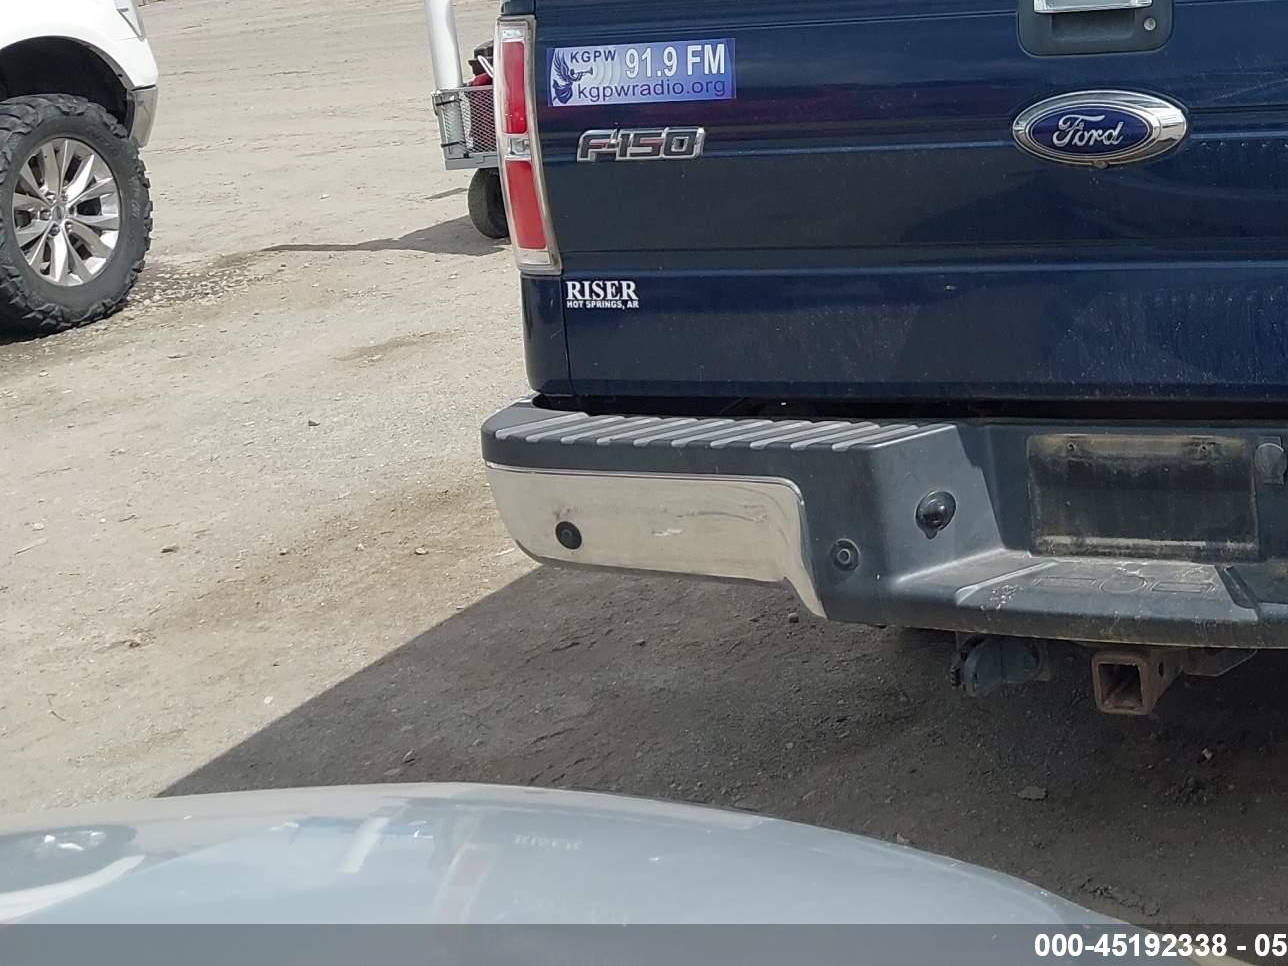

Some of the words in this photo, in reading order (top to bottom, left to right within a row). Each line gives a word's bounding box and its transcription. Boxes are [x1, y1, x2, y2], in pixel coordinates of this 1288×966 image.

[570, 49, 617, 64] KGPW
[625, 46, 678, 78] 91.9
[687, 43, 726, 76] FM
[578, 79, 726, 103] kgpwradio.org
[1052, 114, 1125, 147] Ford
[565, 280, 640, 301] RISER
[566, 300, 584, 309] HOT
[585, 300, 626, 310] SPRINGS,
[626, 300, 640, 309] AR
